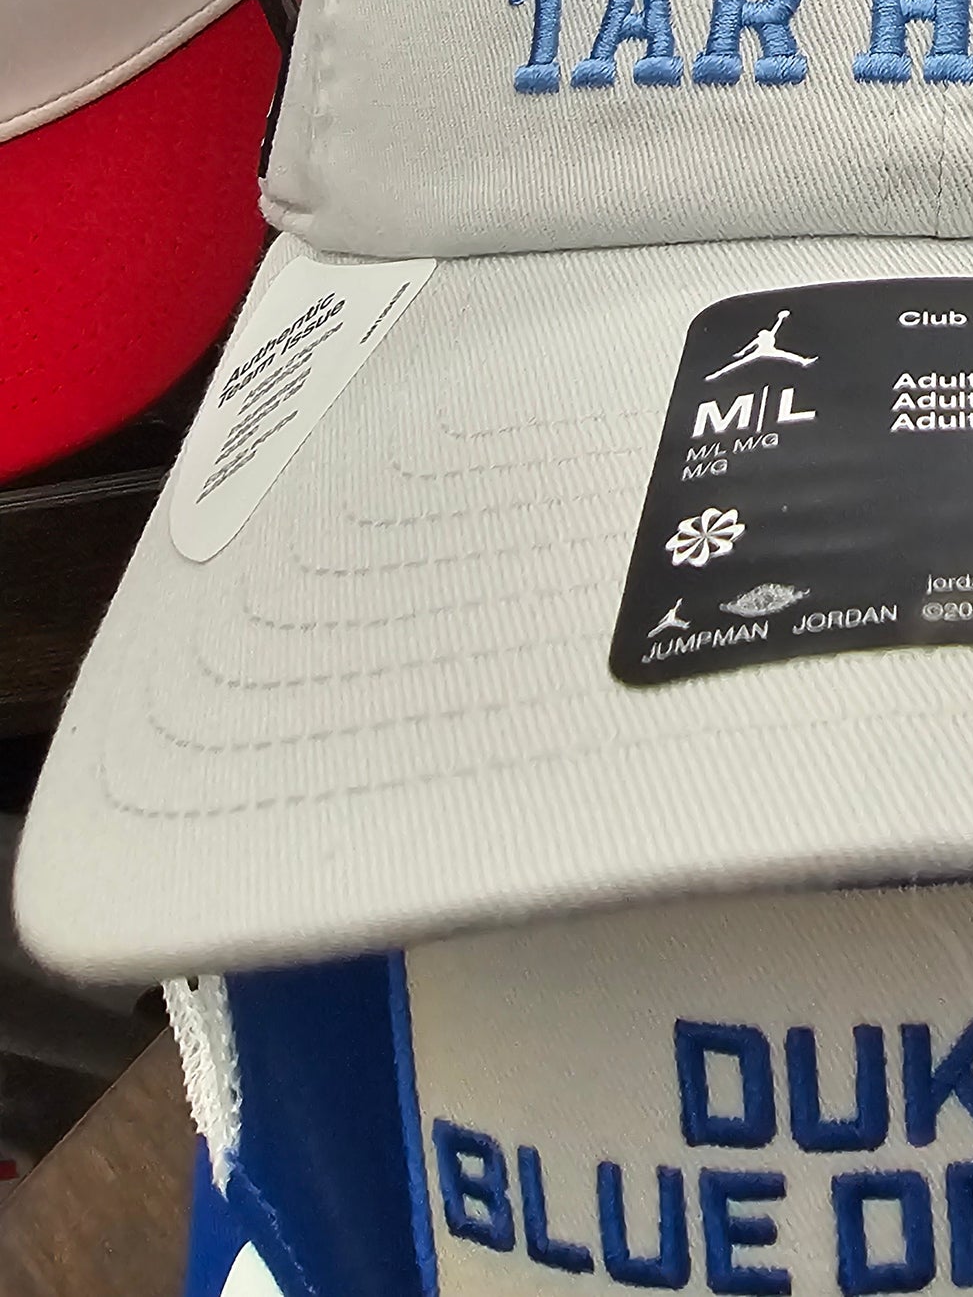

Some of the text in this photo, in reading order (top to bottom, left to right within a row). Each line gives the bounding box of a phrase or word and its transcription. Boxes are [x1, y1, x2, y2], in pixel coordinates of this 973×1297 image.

[222, 292, 336, 391] Authentic
[899, 310, 968, 327] Club
[218, 353, 276, 408] Team
[281, 299, 346, 355] Issue
[681, 459, 728, 482] M/G
[686, 433, 779, 463] M/L M/G
[641, 604, 898, 664] JUMPMAN JORDAN
[432, 1118, 792, 1296] BLUE
